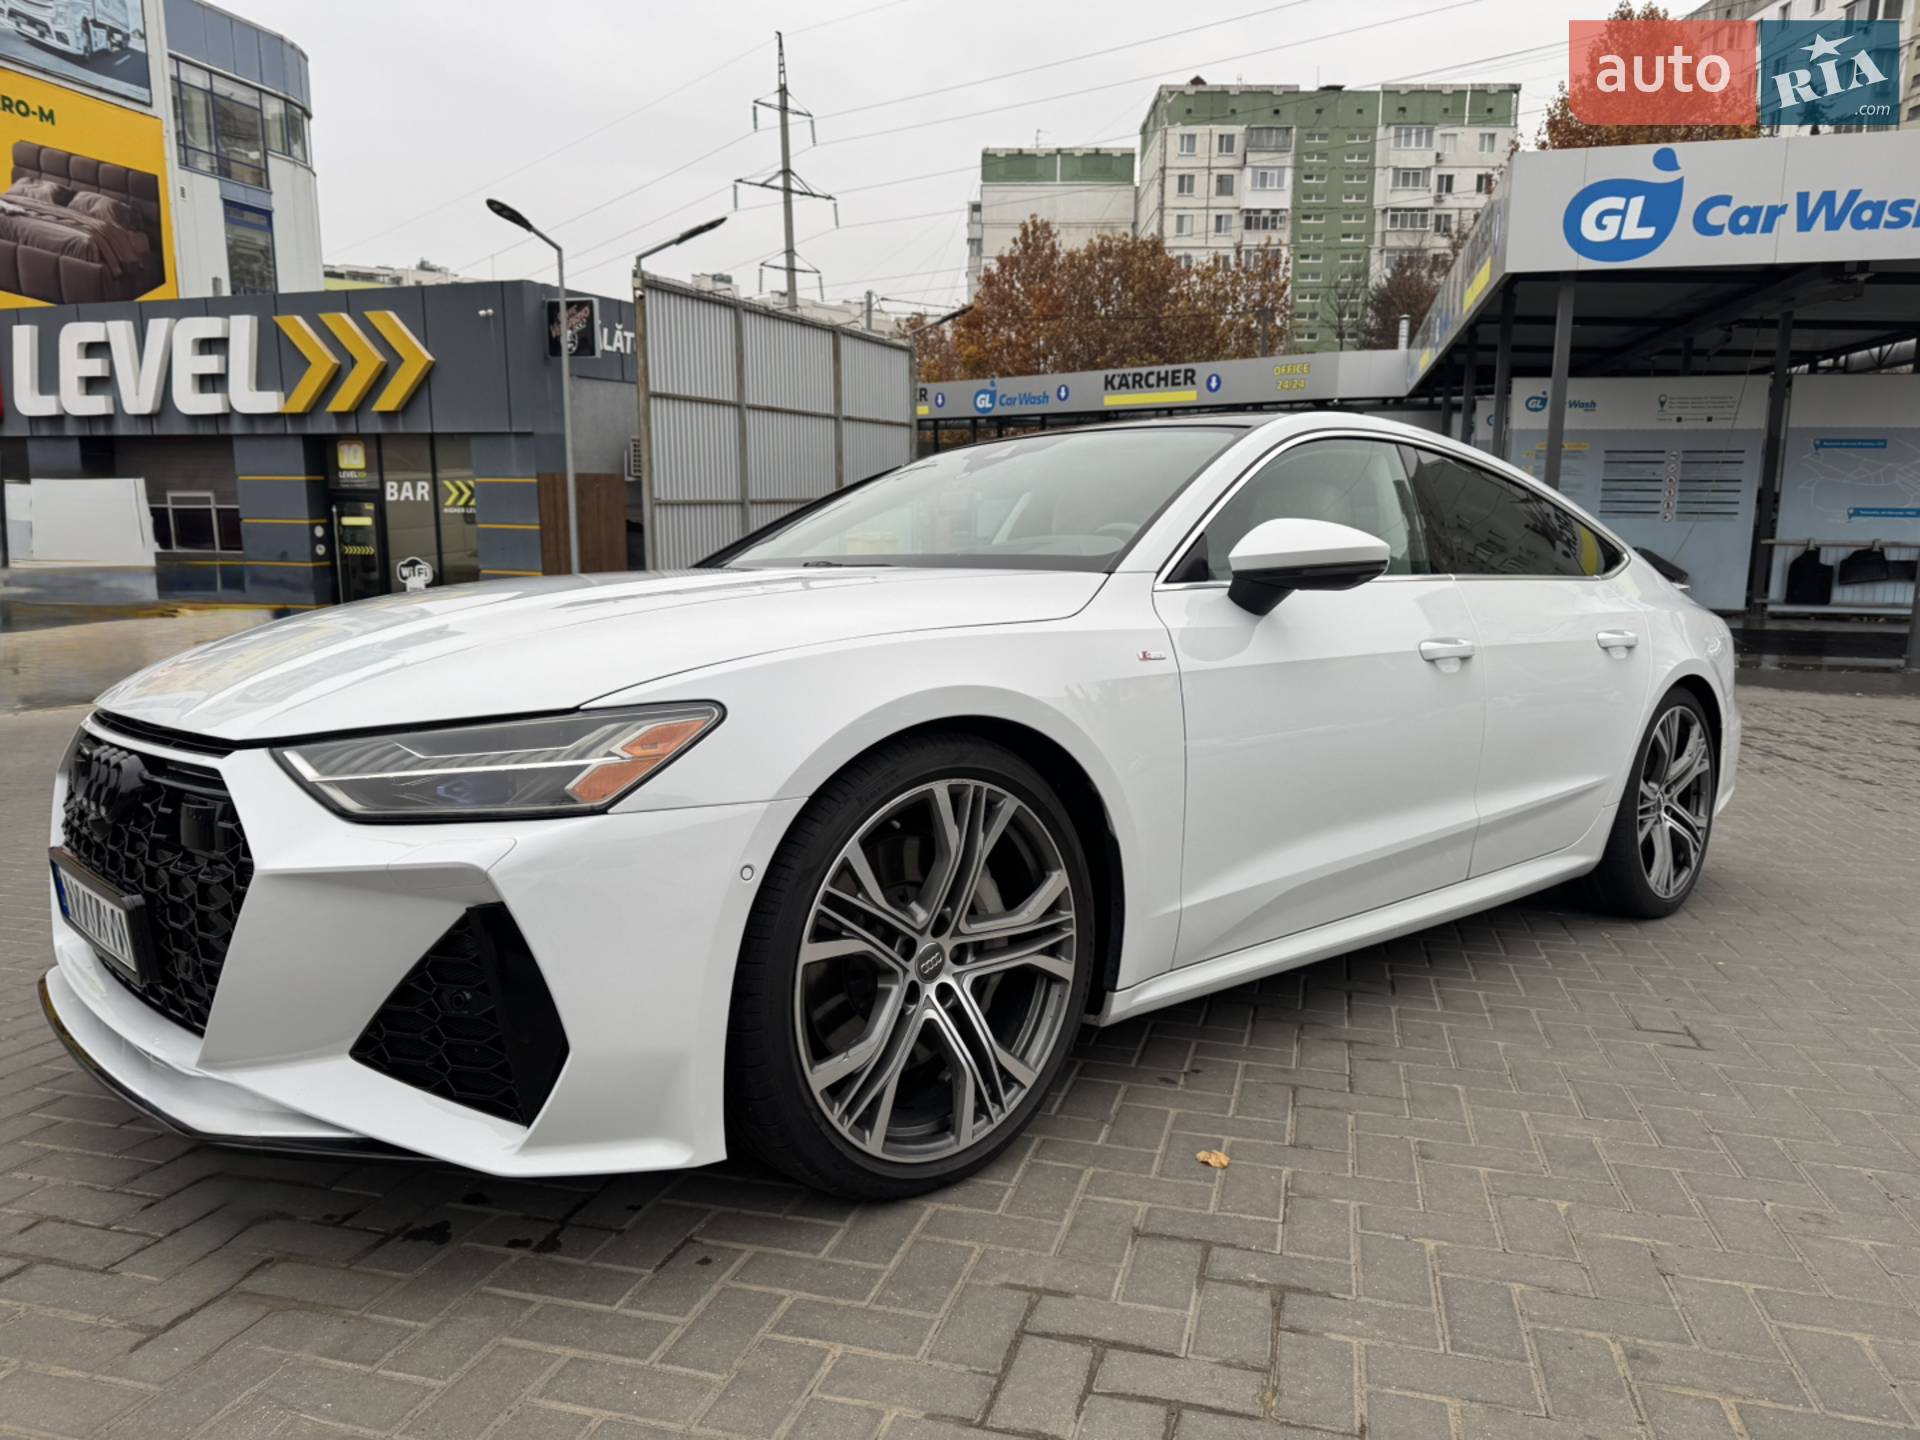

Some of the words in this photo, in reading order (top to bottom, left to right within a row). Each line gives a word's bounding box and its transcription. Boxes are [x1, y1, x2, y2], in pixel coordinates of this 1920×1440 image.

[0, 94, 56, 126] RO-M
[1580, 196, 1656, 242] GL
[1692, 194, 1788, 236] Car
[1796, 188, 1920, 233] Was
[600, 322, 637, 354] LĂT
[12, 315, 285, 416] LEVEL
[1273, 363, 1310, 377] OFFICE
[1104, 368, 1197, 391] KÄRCHER
[976, 394, 993, 408] GL
[999, 394, 1018, 406] Car
[1018, 391, 1049, 405] Wash
[1568, 399, 1597, 409] Wash
[340, 444, 361, 465] 10
[386, 481, 430, 501] BAR
